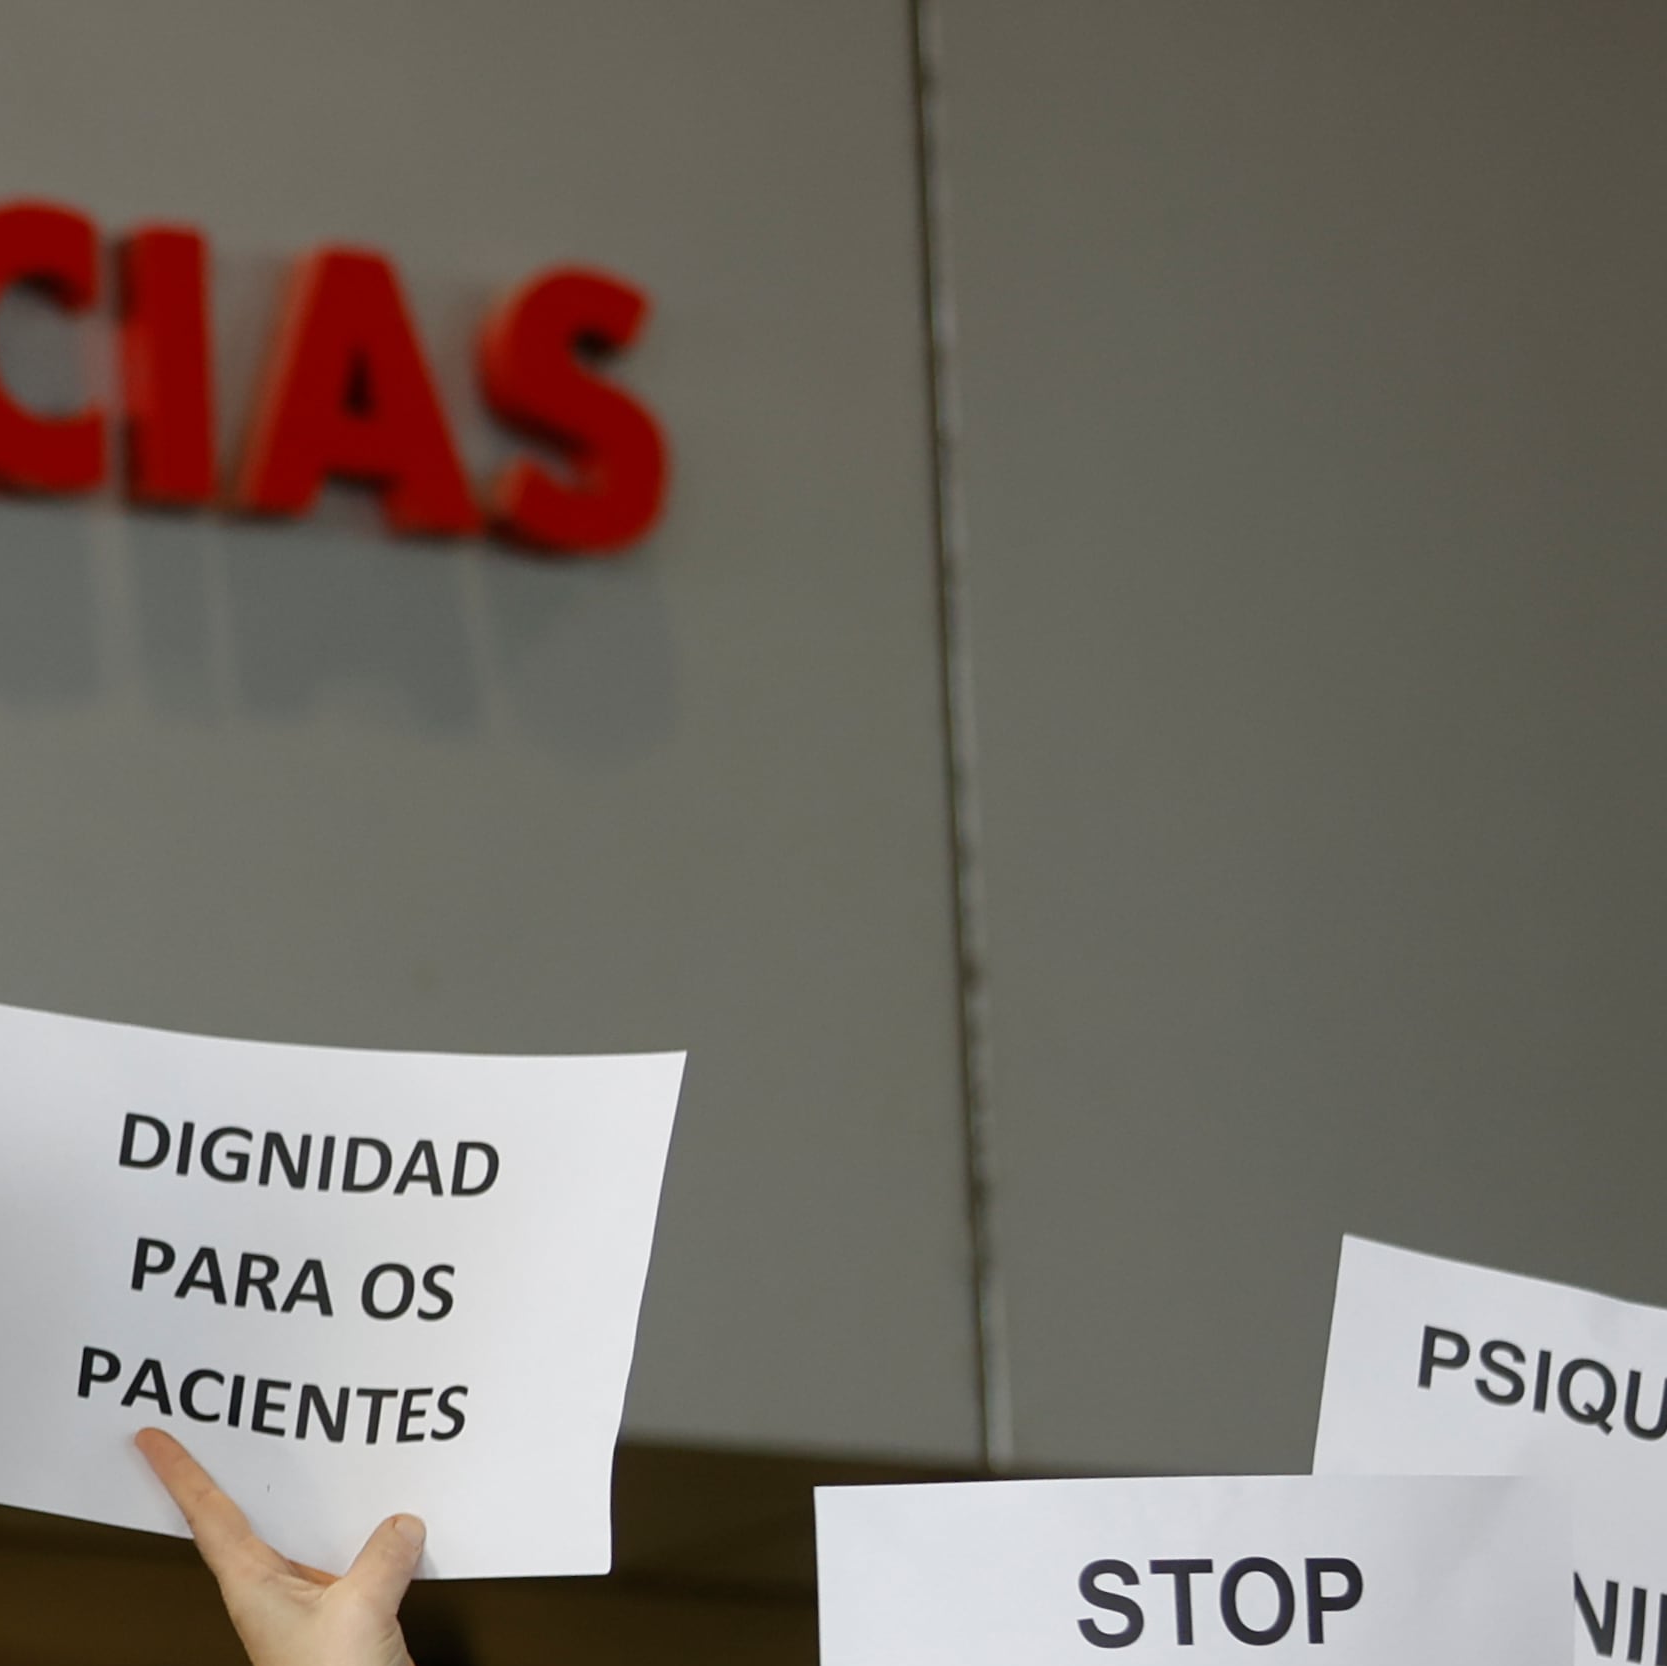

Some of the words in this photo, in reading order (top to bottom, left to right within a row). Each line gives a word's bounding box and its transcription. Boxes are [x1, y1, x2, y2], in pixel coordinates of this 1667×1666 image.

[118, 1112, 500, 1198] DIGNIDAD
[130, 1237, 334, 1317] PARA
[359, 1262, 455, 1322] OS
[77, 1345, 469, 1446] PACIENTES
[1417, 1325, 1667, 1441] PSIQU
[1076, 1555, 1365, 1649] STOP
